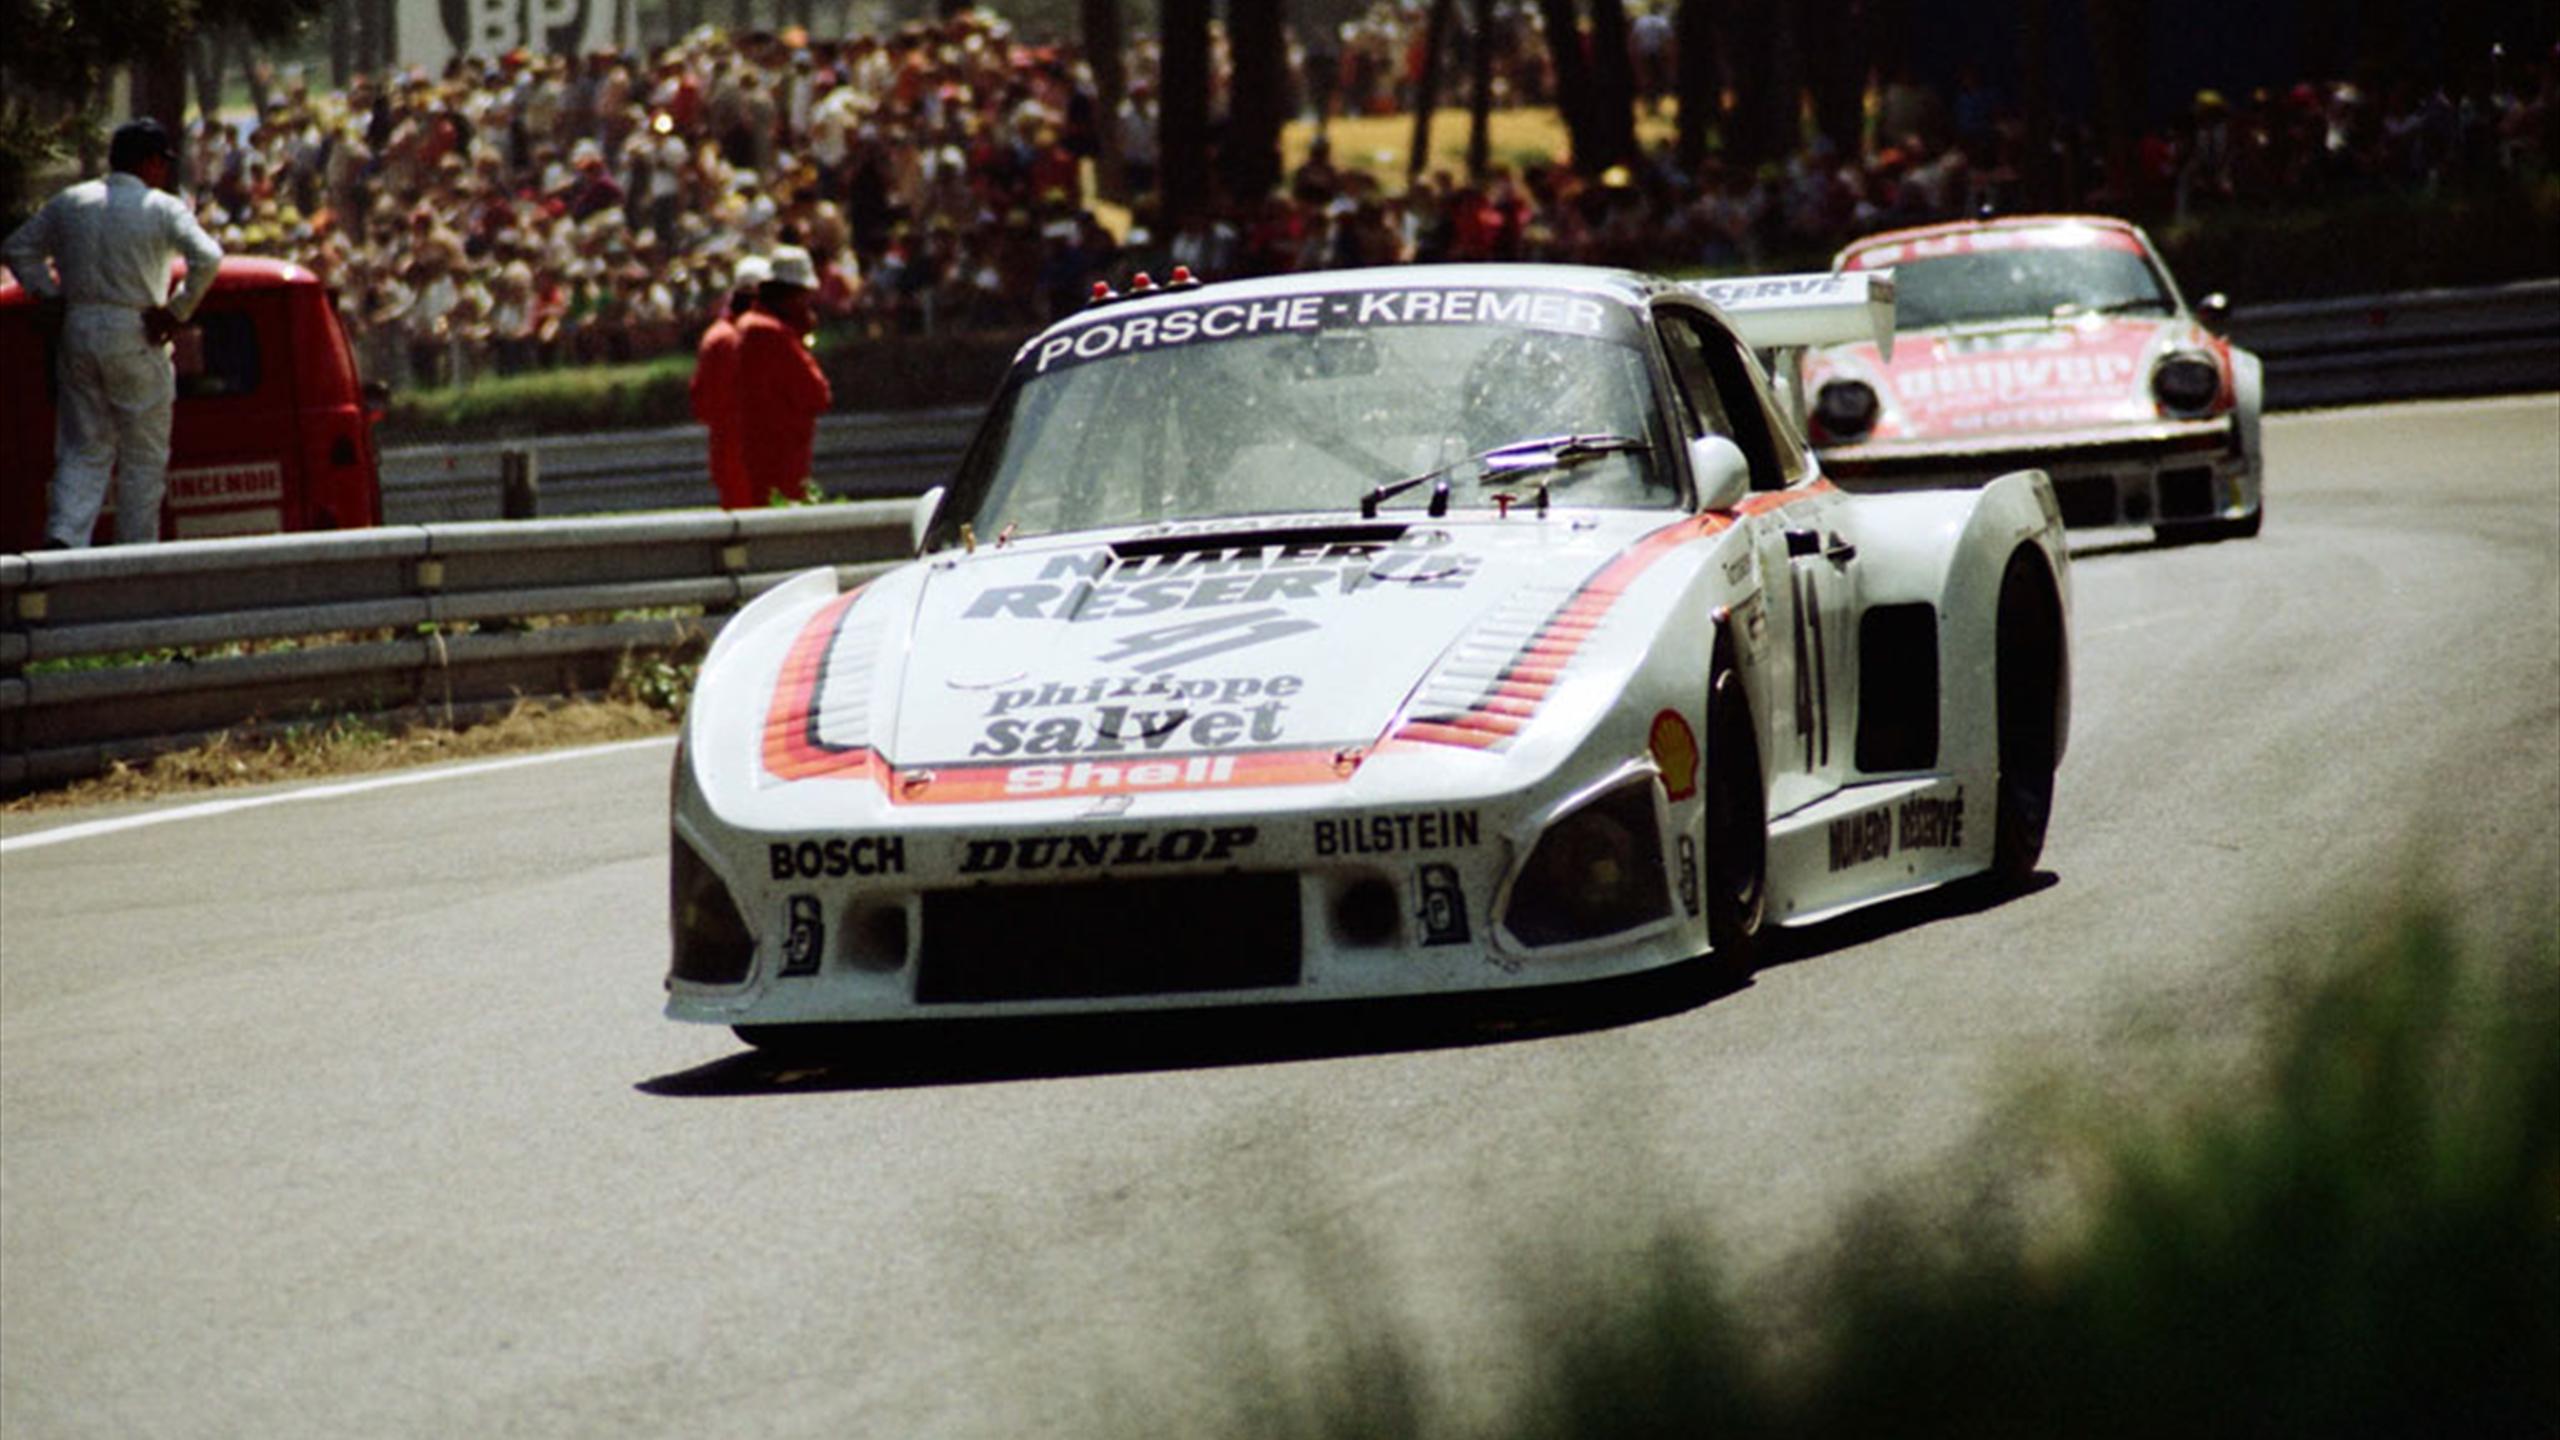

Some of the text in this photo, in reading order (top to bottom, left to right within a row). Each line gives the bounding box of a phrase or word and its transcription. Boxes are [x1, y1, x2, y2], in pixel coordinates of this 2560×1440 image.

[470, 0, 578, 53] BP
[170, 466, 278, 499] INCENDIE
[985, 673, 1304, 717] philippe
[970, 700, 1289, 756] salvet
[1005, 756, 1237, 794] Shell
[958, 826, 1257, 873] DUNLOP
[1315, 810, 1479, 855] BILSTEIN
[769, 836, 904, 880] BOSCH
